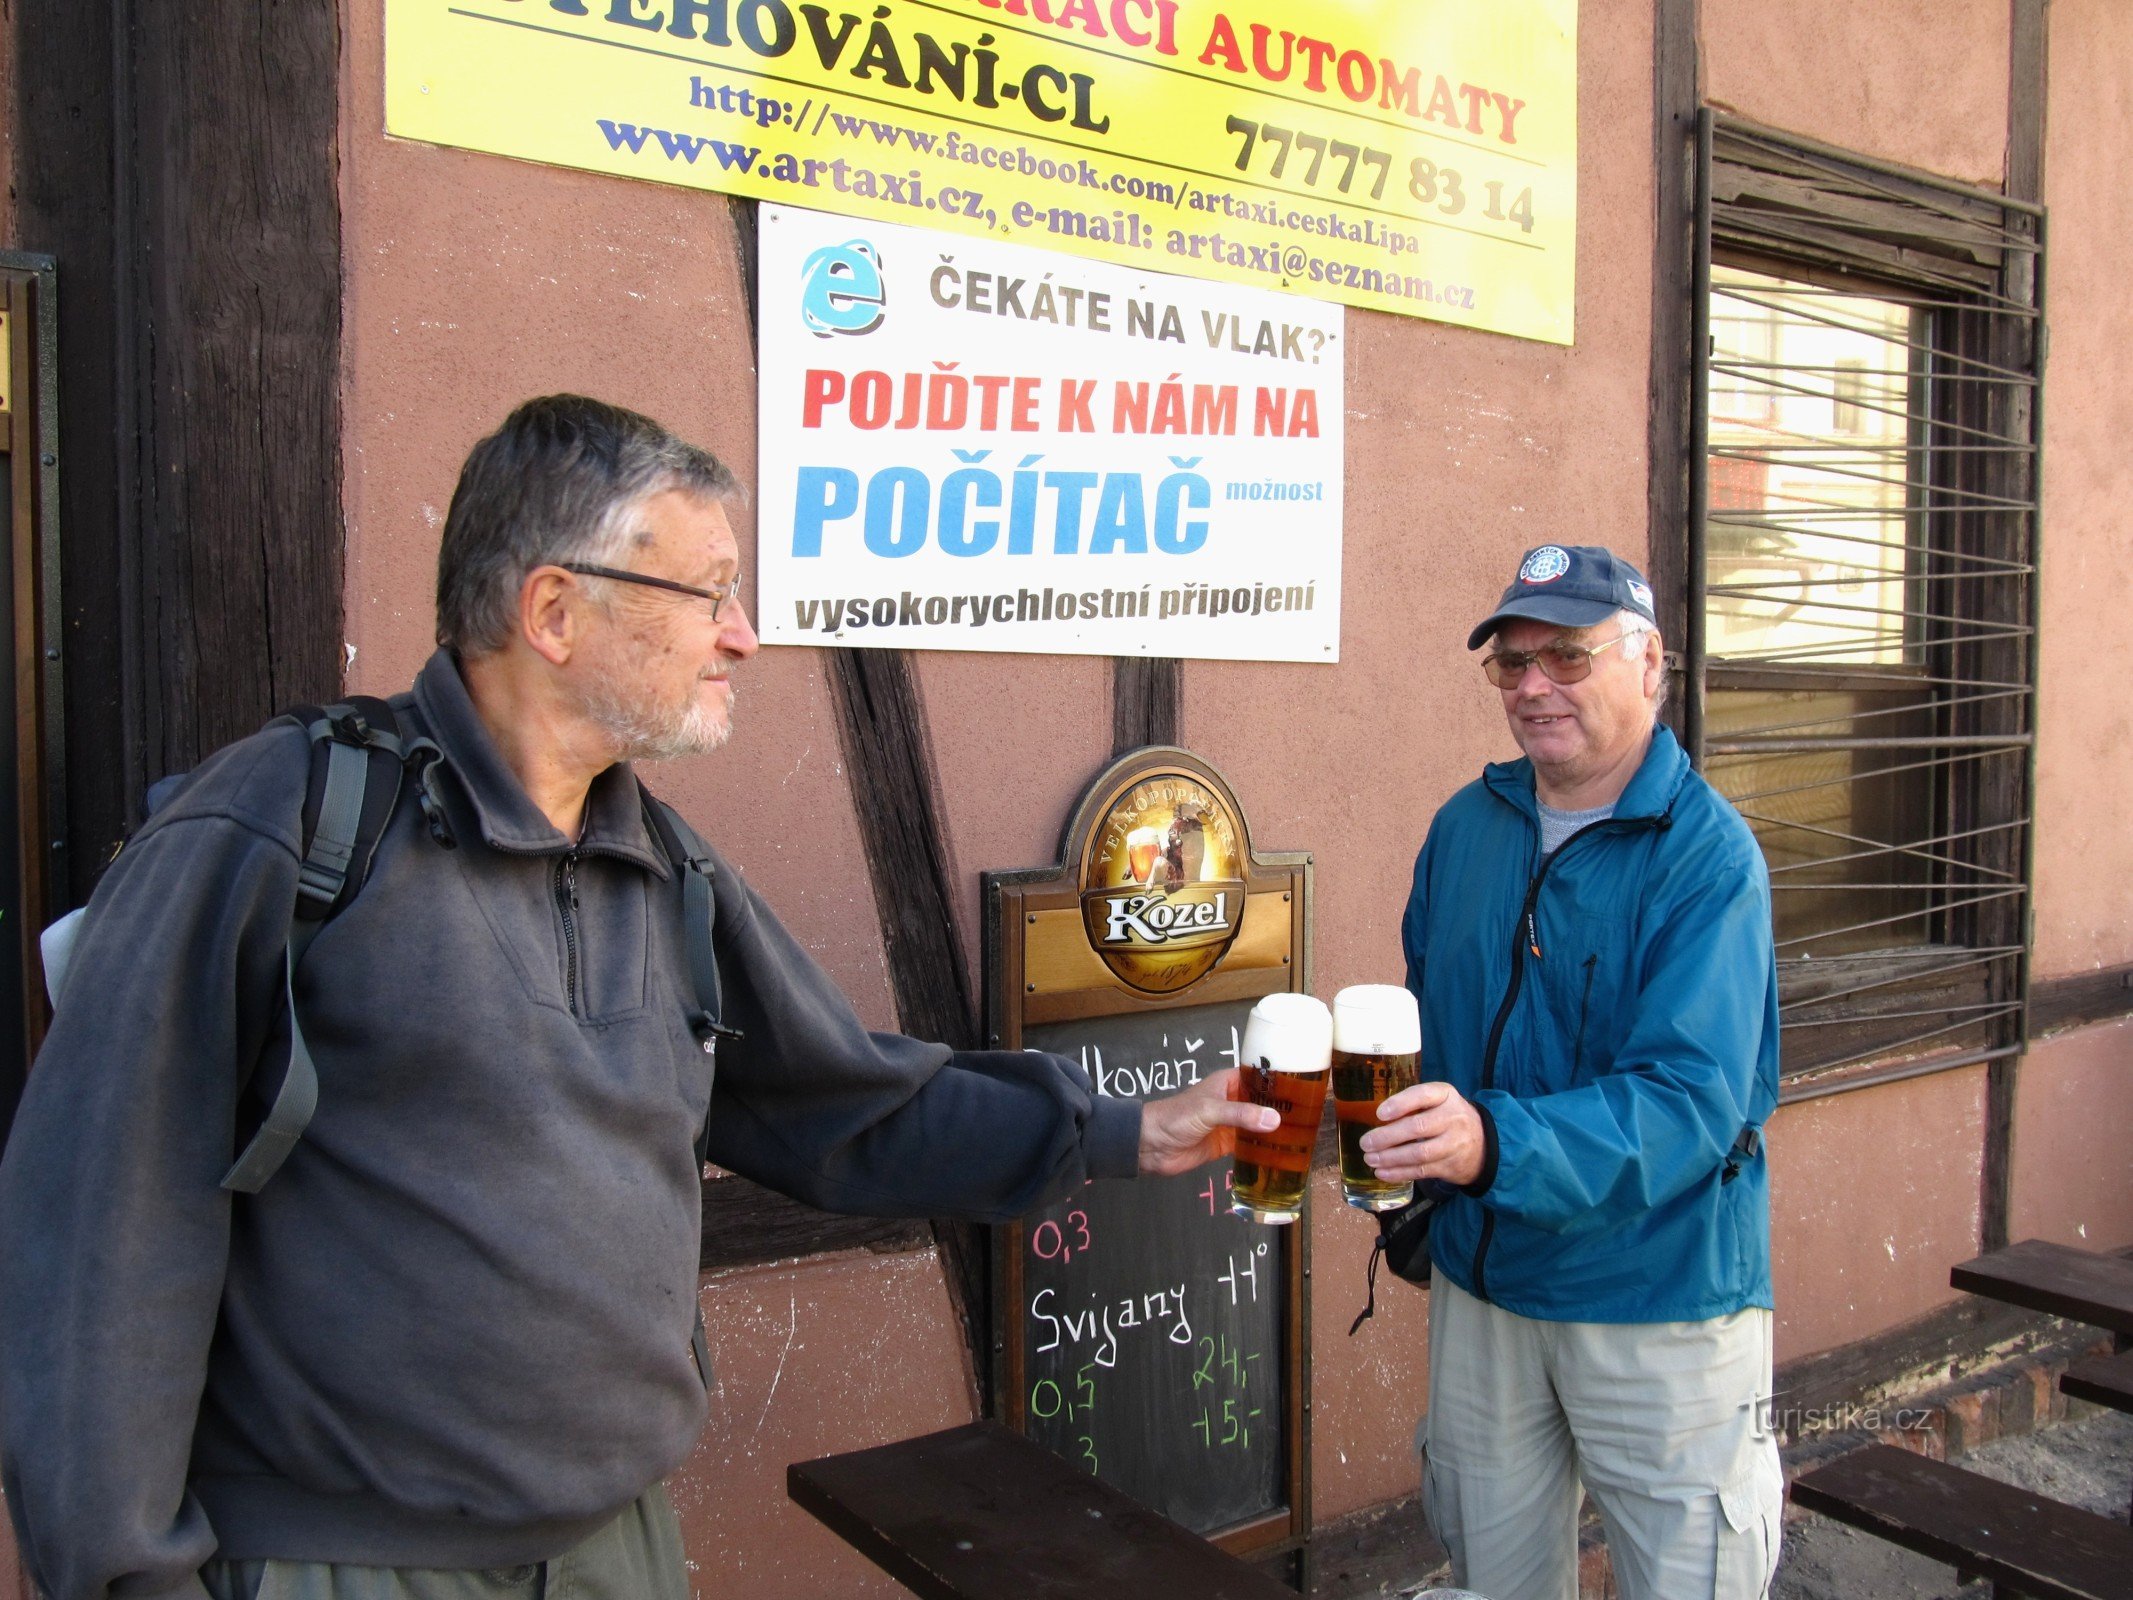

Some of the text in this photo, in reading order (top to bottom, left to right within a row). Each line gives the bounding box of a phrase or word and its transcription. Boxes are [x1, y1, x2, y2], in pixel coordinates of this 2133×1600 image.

[500, 0, 1110, 135] HOVÁNÍ-CL
[1197, 13, 1526, 144] AUTOMATY
[596, 119, 1475, 310] www.artaxi.cz, e-mail: artaxi@seznam.cz
[1226, 114, 1535, 234] 77777 83 14
[930, 253, 1327, 364] ČEKÁTE NA VLAK?
[801, 361, 1321, 438] POJĎTE K NÁM NA
[791, 448, 1212, 559] POČÍTAČ
[1226, 480, 1324, 503] možnost
[794, 579, 1316, 633] vysokorychlostní připojení
[1104, 892, 1230, 943] Kozel
[1032, 1210, 1091, 1264] 0,3
[1031, 1283, 1192, 1367] Svijany
[1031, 1362, 1095, 1424] 0,5
